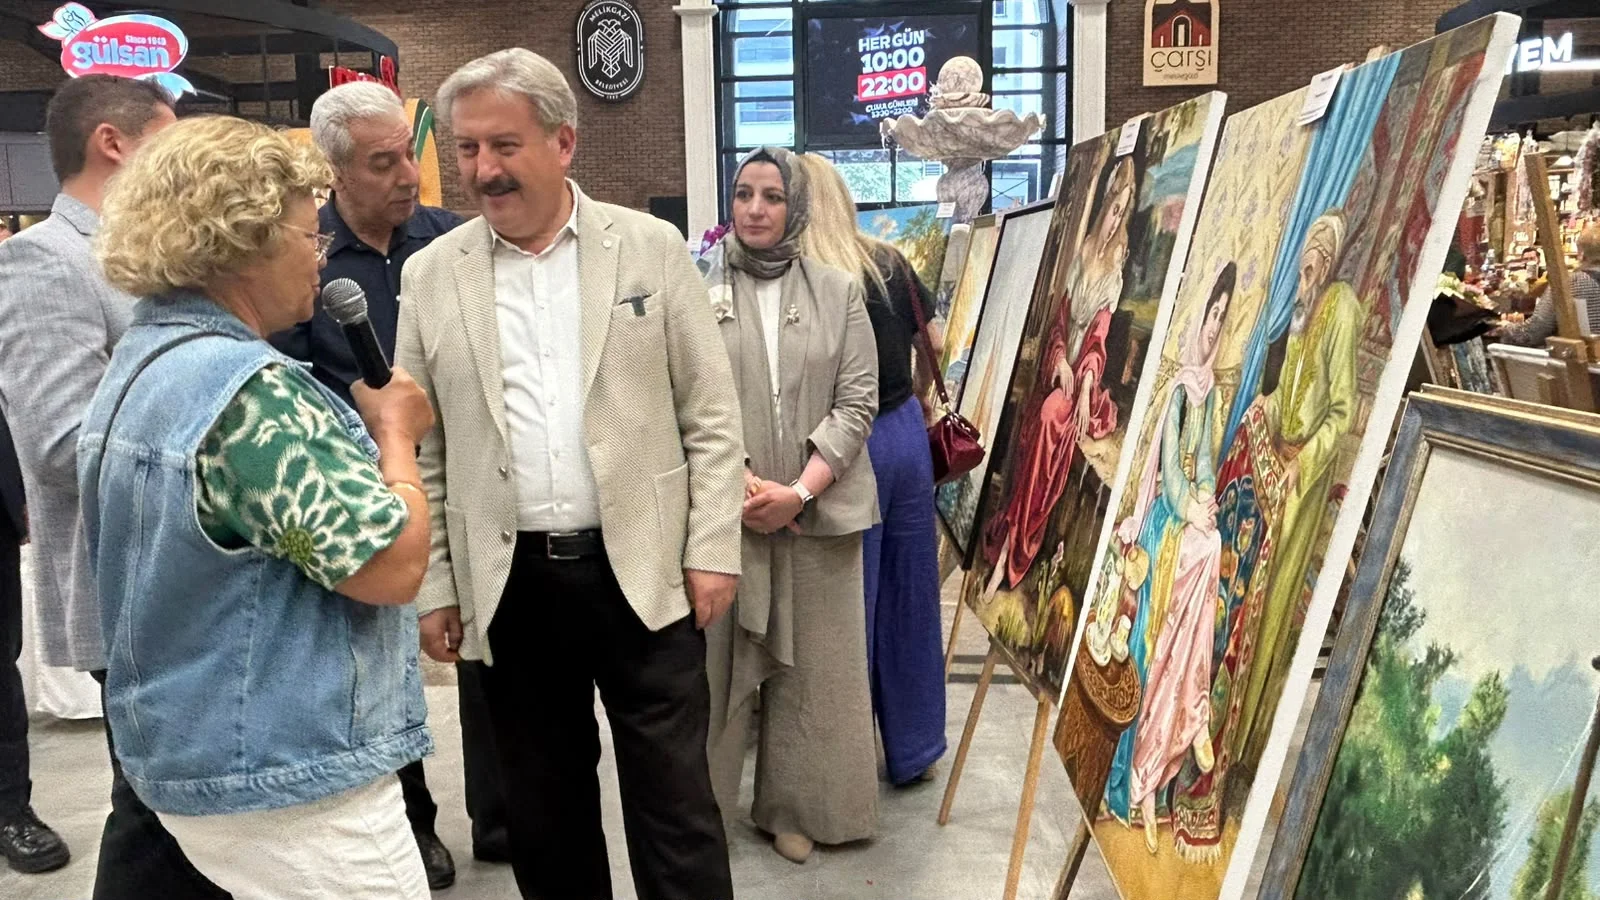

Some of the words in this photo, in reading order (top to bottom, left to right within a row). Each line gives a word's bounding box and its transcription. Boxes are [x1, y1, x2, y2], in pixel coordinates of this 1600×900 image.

[71, 35, 170, 69] gülsan
[858, 35, 890, 52] HER
[892, 28, 925, 47] GÜN
[860, 46, 925, 74] 10:00
[861, 71, 924, 98] 22:00
